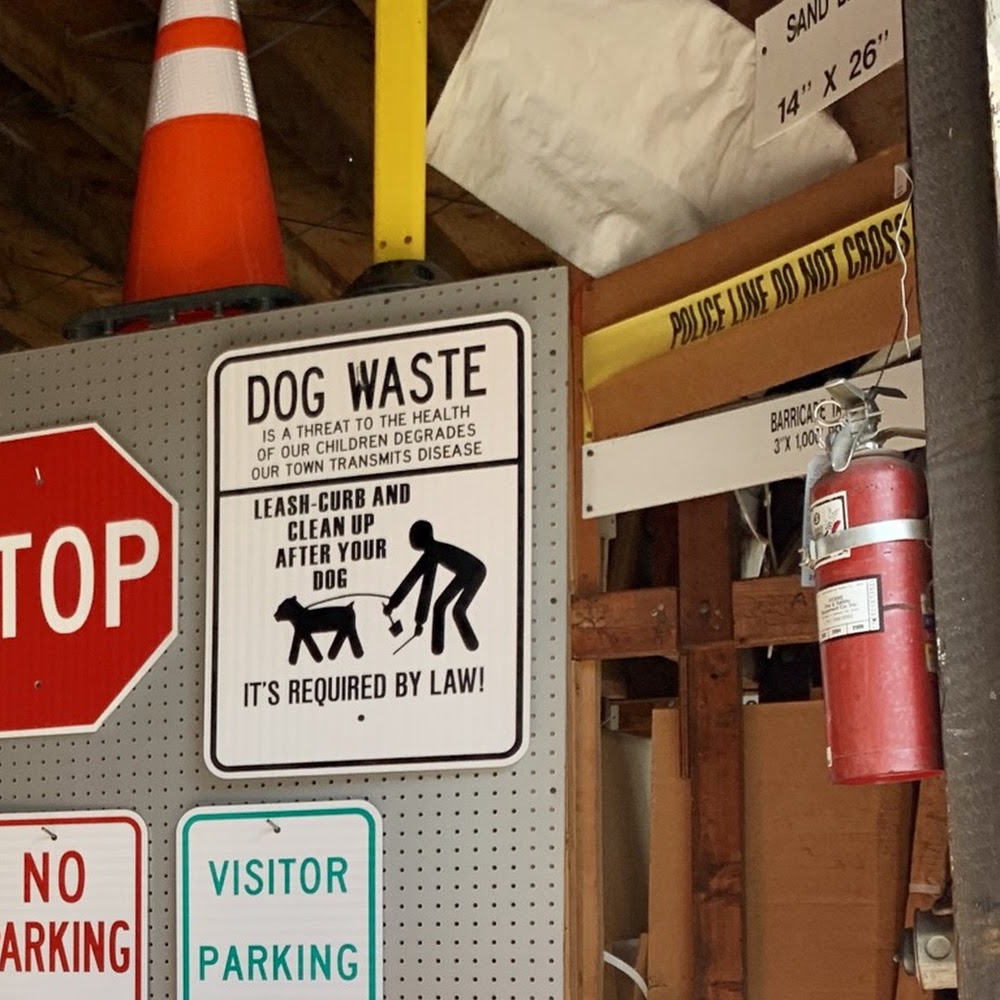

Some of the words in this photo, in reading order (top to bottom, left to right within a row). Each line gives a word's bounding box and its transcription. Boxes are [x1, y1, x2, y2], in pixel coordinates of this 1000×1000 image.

[786, 0, 829, 43] SAND
[823, 64, 837, 98] X
[669, 293, 725, 350] POLICE
[727, 273, 769, 325] LINE
[770, 262, 799, 311] DO
[798, 243, 838, 299] NOT
[842, 213, 911, 280] CROSS
[248, 366, 325, 425] DOG
[347, 344, 487, 412] WASTE
[257, 447, 275, 462] OF
[281, 444, 310, 460] OUR
[316, 435, 388, 455] CHILDREN
[394, 423, 477, 446] DEGRADES
[262, 429, 276, 443] IS
[282, 427, 292, 441] A
[297, 420, 350, 438] THREAT
[356, 416, 373, 431] TO
[380, 413, 407, 429] THE
[412, 404, 471, 424] HEALTH
[251, 465, 280, 480] OUR
[286, 460, 324, 477] TOWN
[329, 452, 412, 473] TRANSMITS
[418, 441, 483, 462] DISEASE
[254, 487, 366, 519] LEASH-CURB
[372, 483, 411, 507] AND
[288, 515, 345, 542] CLEAN
[351, 513, 375, 535] UP
[275, 545, 331, 569] AFTER
[337, 538, 387, 562] YOUR
[313, 568, 348, 591] DOG
[244, 680, 280, 707] IT'S
[288, 672, 387, 706] REQUIRED
[395, 670, 422, 698] BY
[430, 666, 485, 696] LAW!
[23, 850, 86, 904] NO
[208, 856, 349, 896] VISITOR
[199, 944, 358, 982] PARKING
